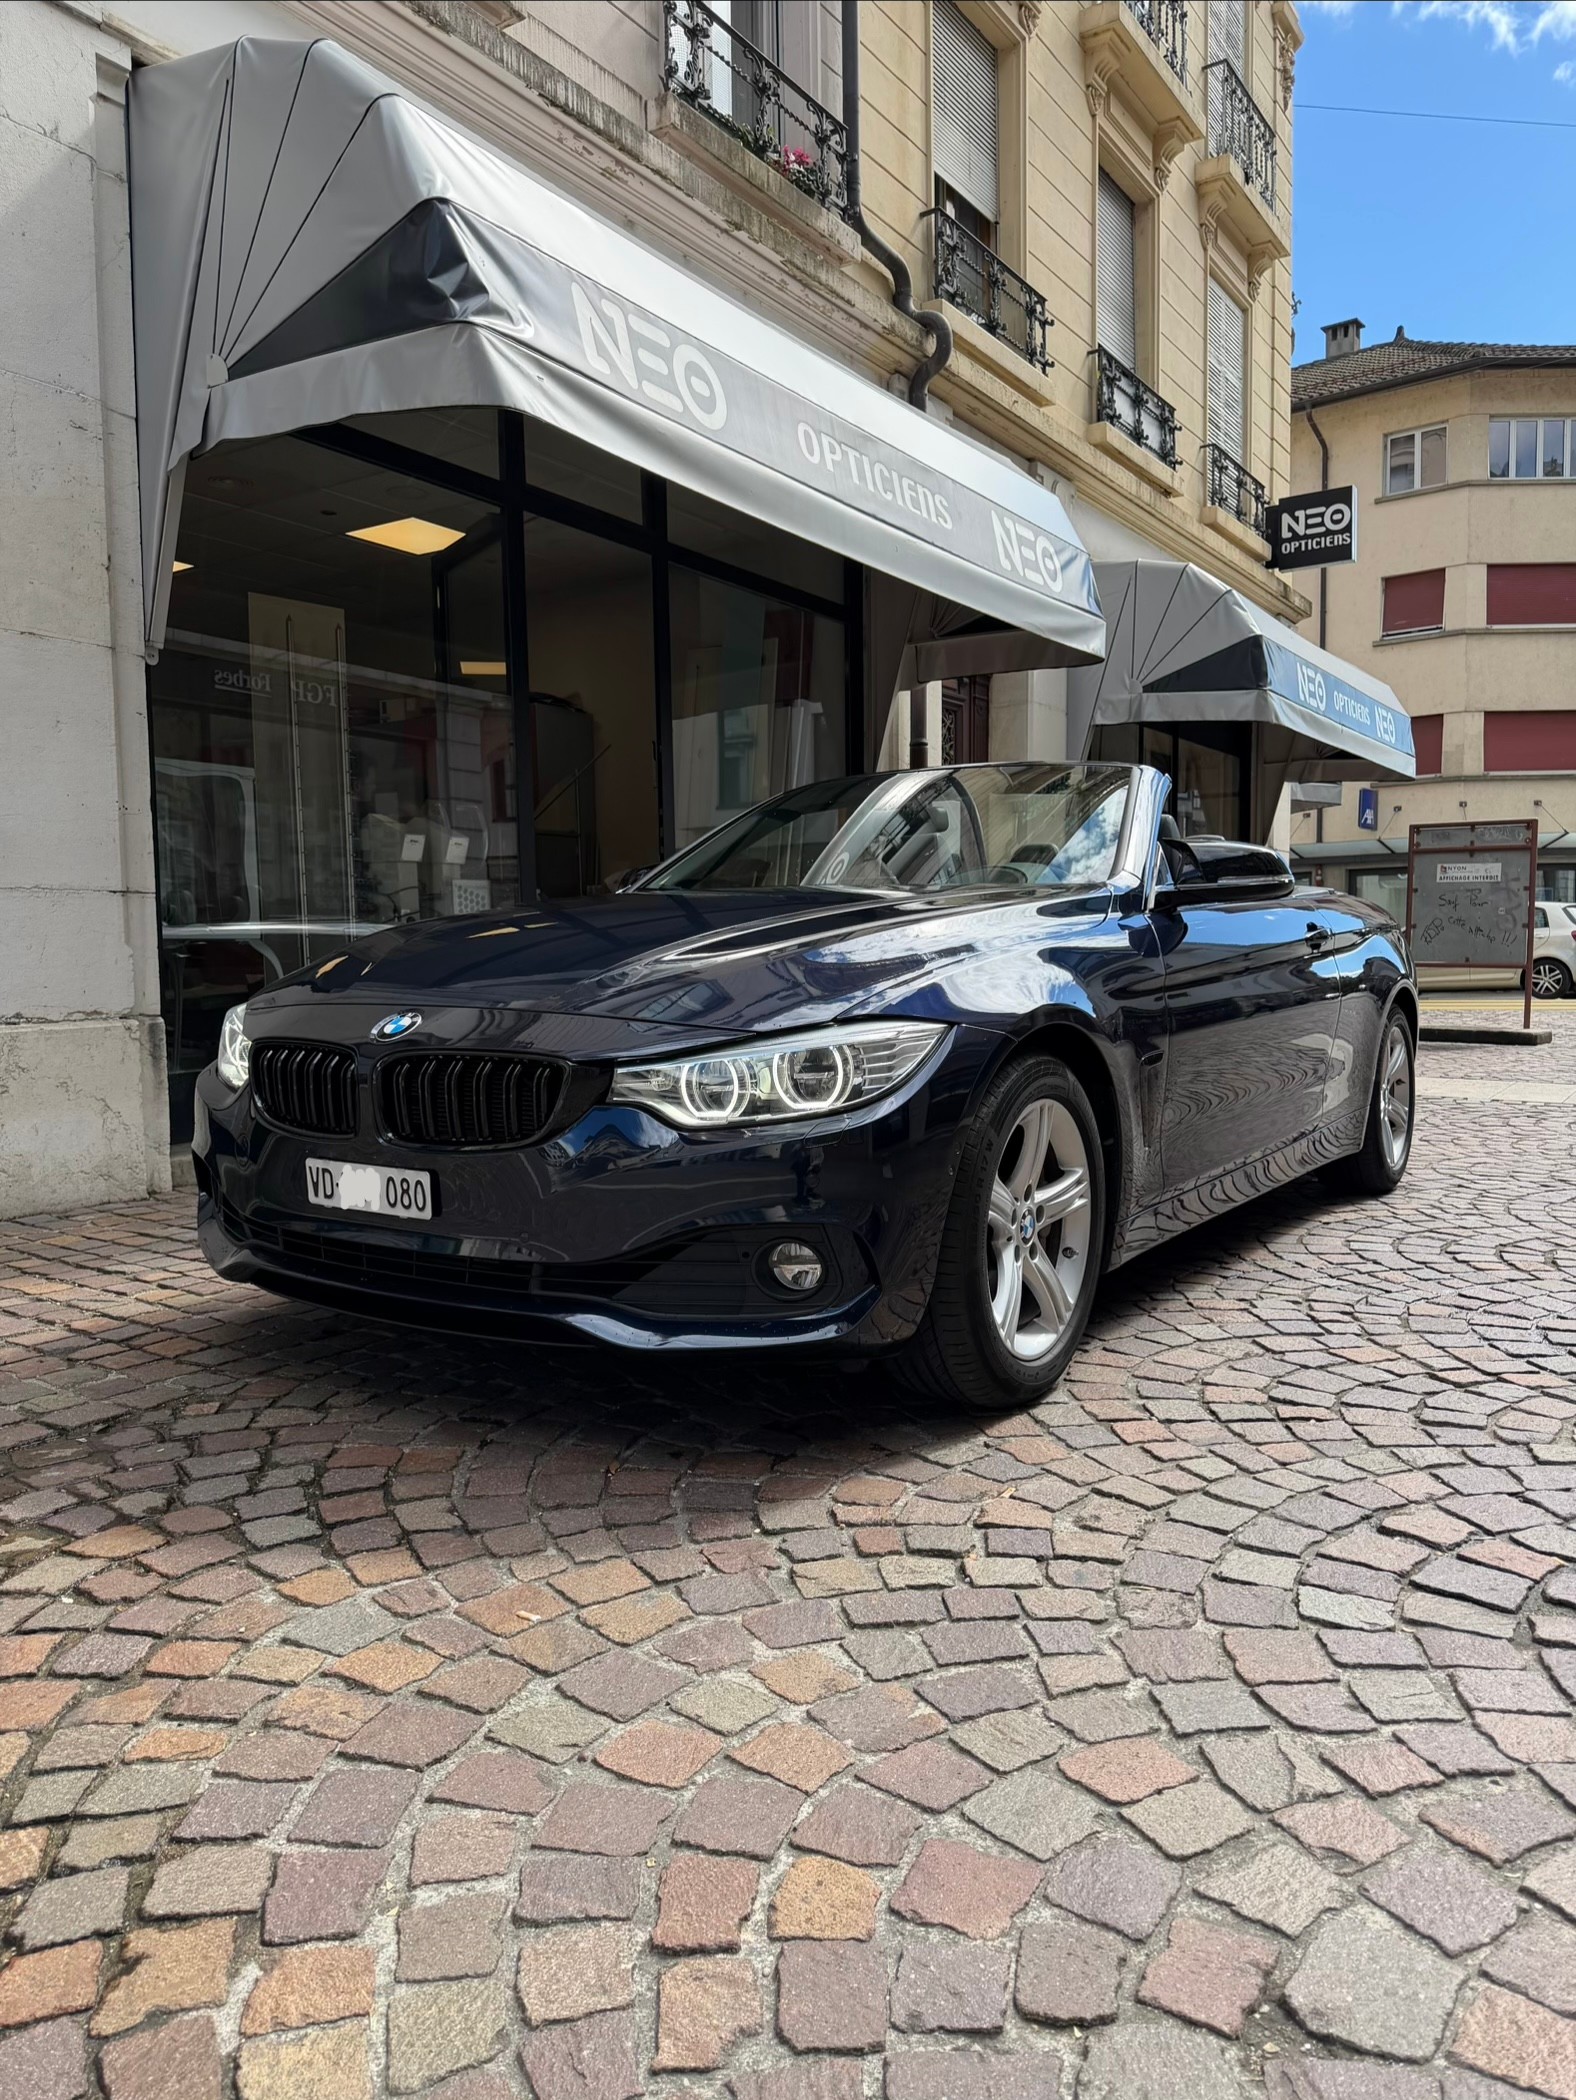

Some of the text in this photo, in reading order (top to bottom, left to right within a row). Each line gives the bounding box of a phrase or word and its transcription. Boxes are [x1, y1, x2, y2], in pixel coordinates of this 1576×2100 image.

[571, 281, 1064, 593] NEO OPTICIENS NEO
[1281, 503, 1351, 539] NEO
[1281, 532, 1351, 555] OPTICIENS
[1297, 662, 1396, 744] NEO OPTICIENS NEO
[385, 1175, 427, 1212] 080
